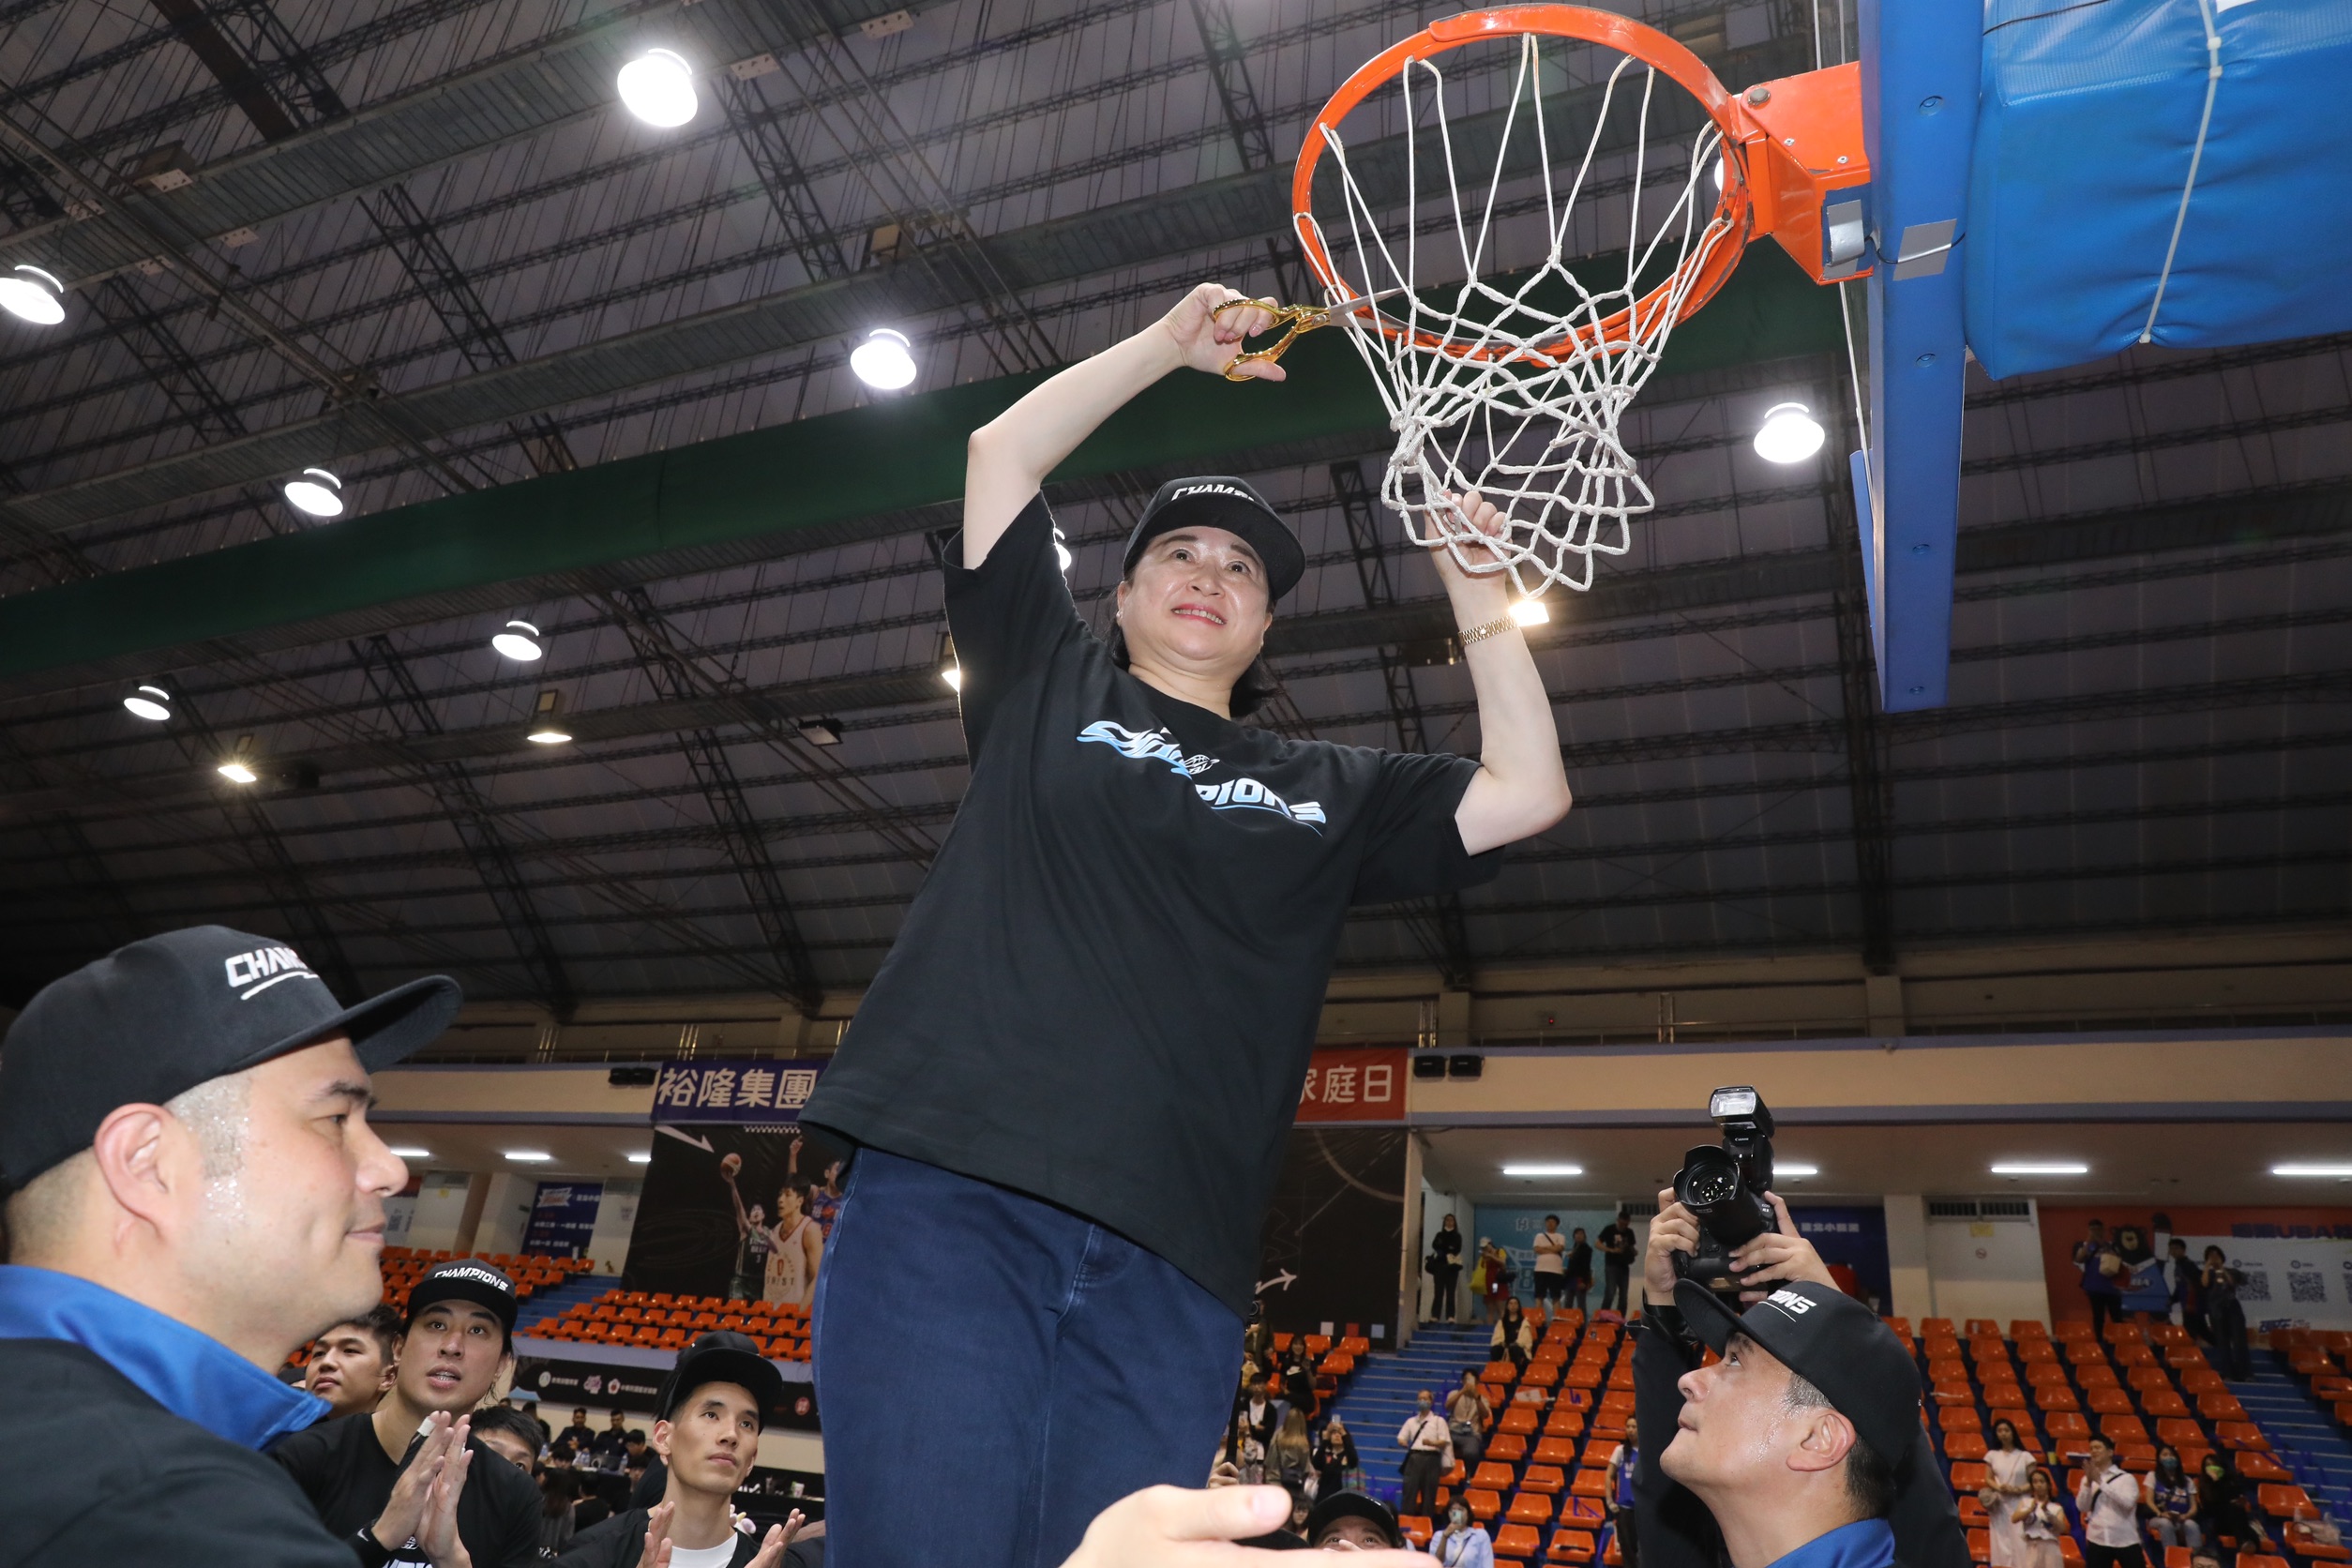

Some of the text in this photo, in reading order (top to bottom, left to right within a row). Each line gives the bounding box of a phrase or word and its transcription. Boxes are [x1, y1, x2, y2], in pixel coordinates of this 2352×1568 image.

[657, 1068, 818, 1109] 裕隆集團
[434, 1267, 509, 1291] CHAMPIONS
